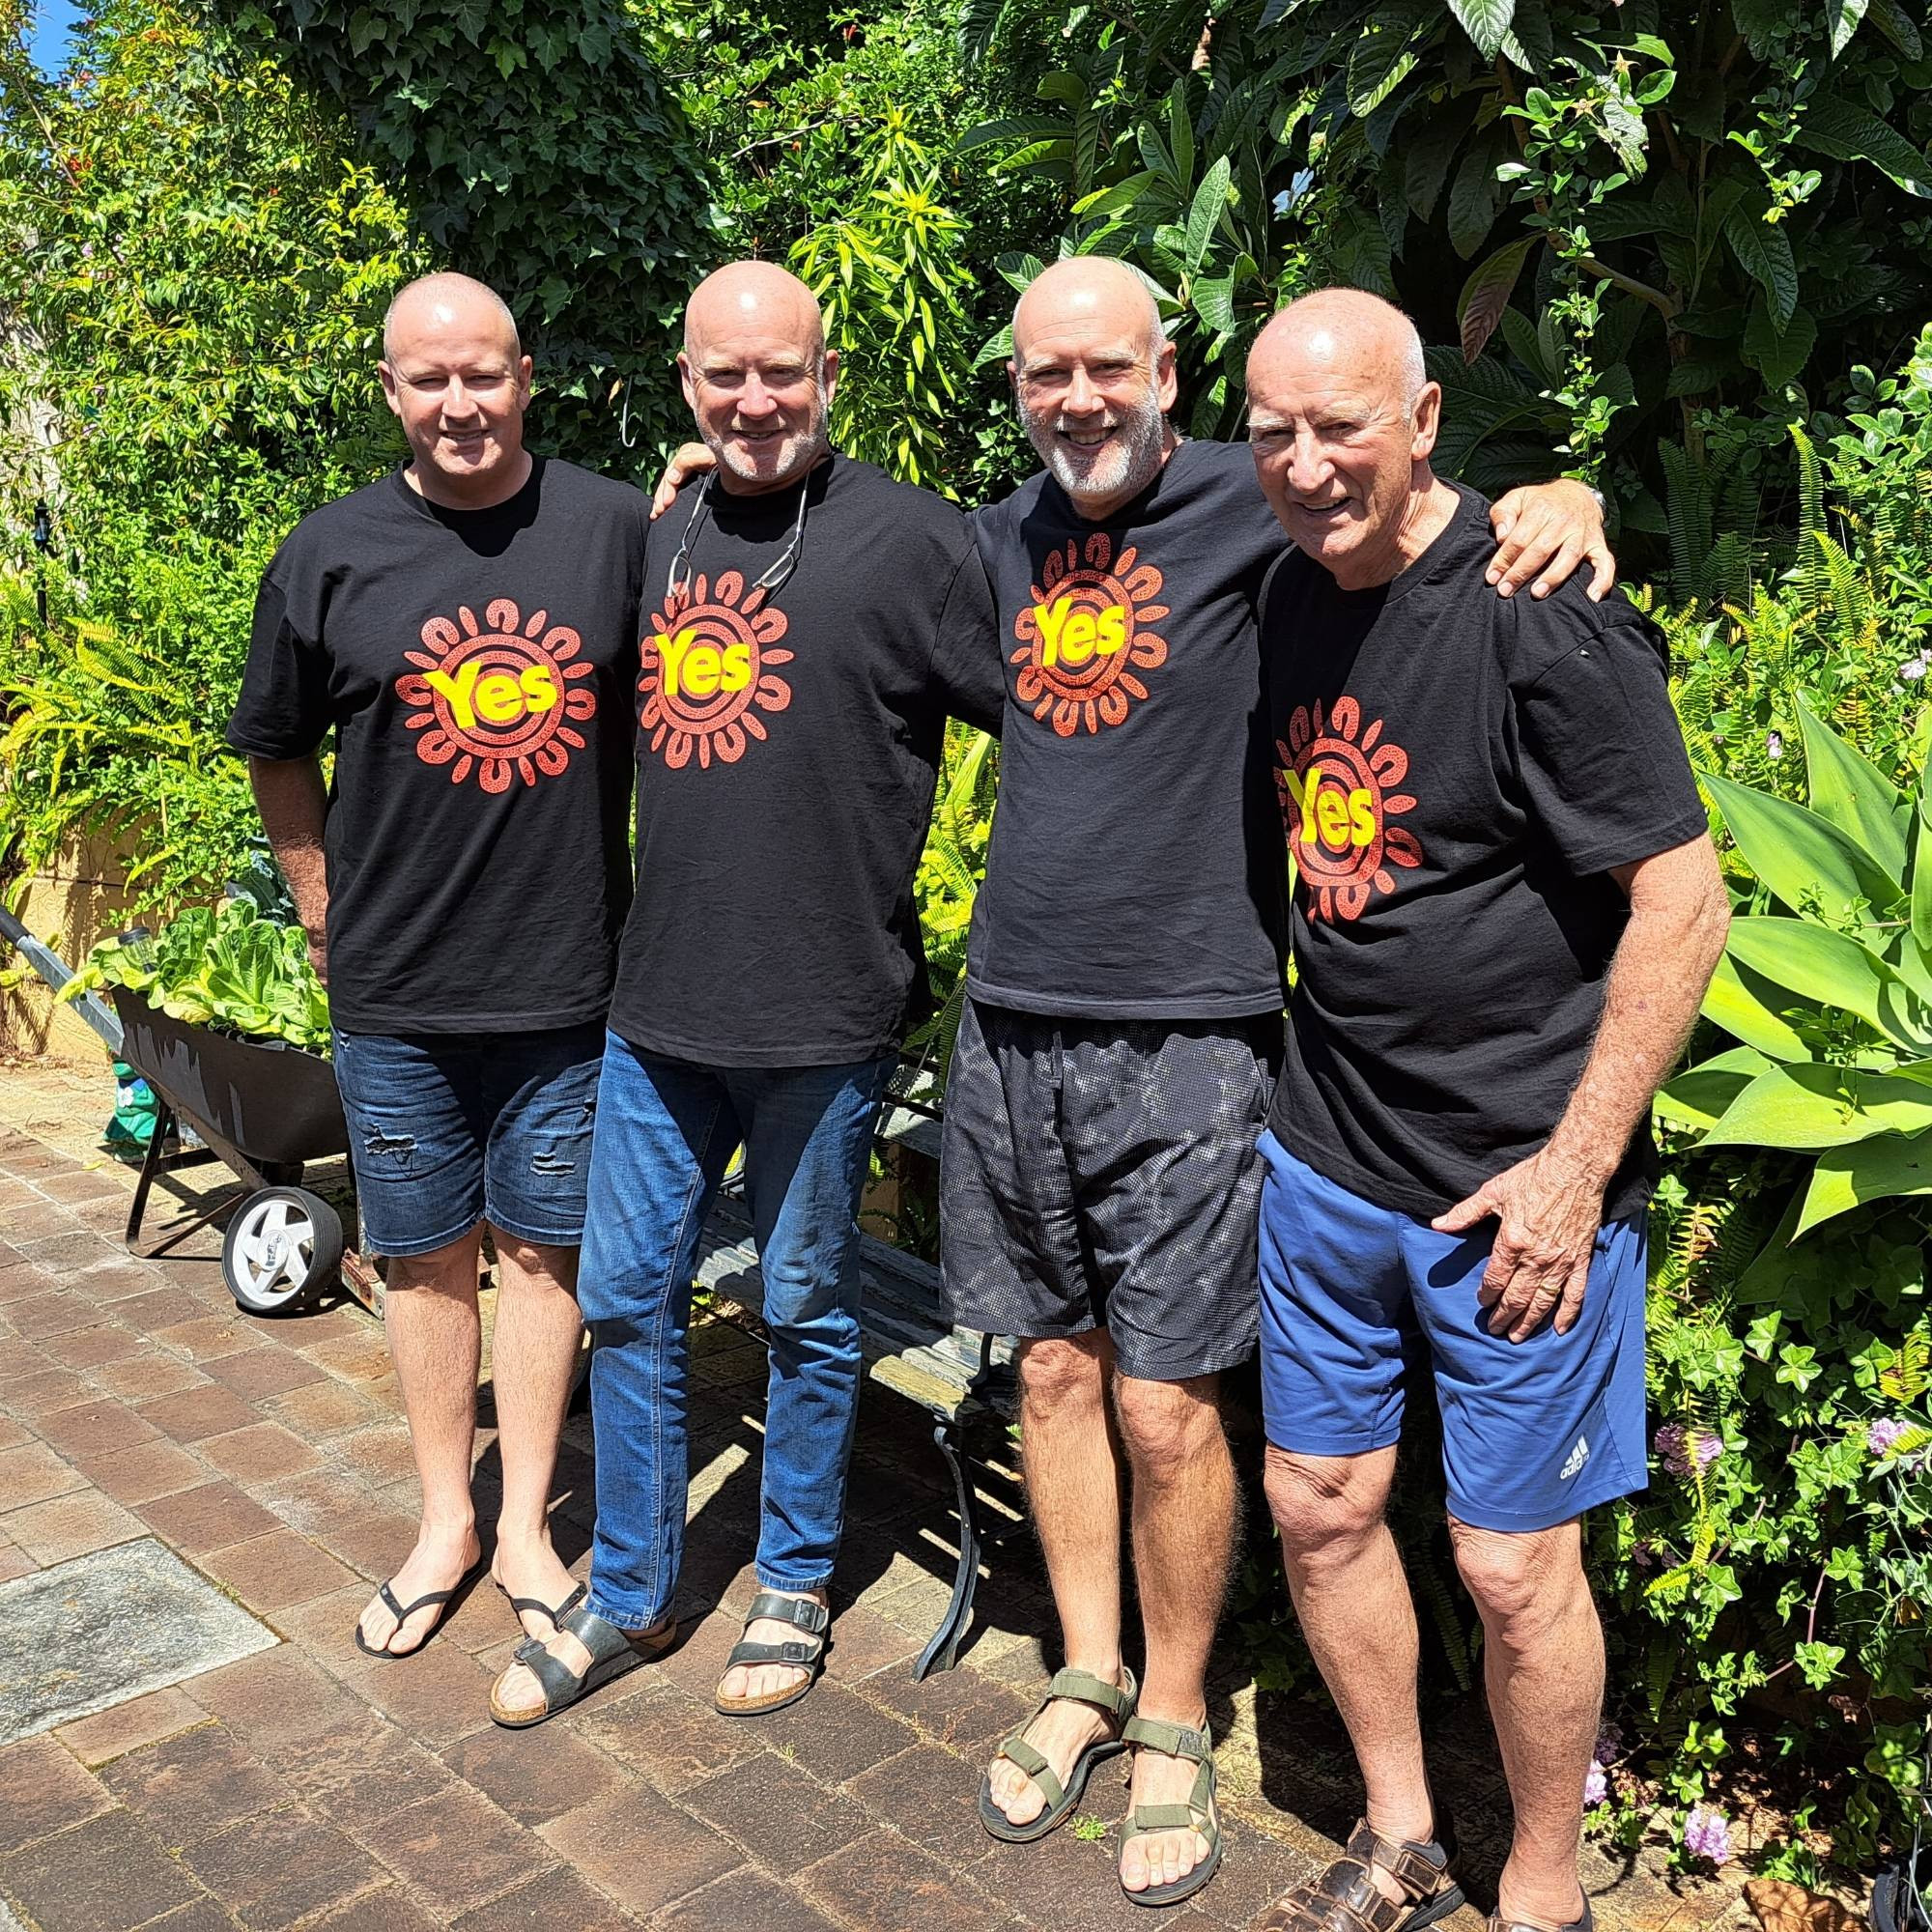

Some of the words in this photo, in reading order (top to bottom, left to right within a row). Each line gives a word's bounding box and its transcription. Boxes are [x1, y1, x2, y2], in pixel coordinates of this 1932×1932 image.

[654, 629, 752, 696] Yes
[1033, 597, 1126, 667] Yes
[422, 661, 557, 730] Yes
[1282, 768, 1377, 846] Yes
[1560, 1453, 1590, 1480] adid
